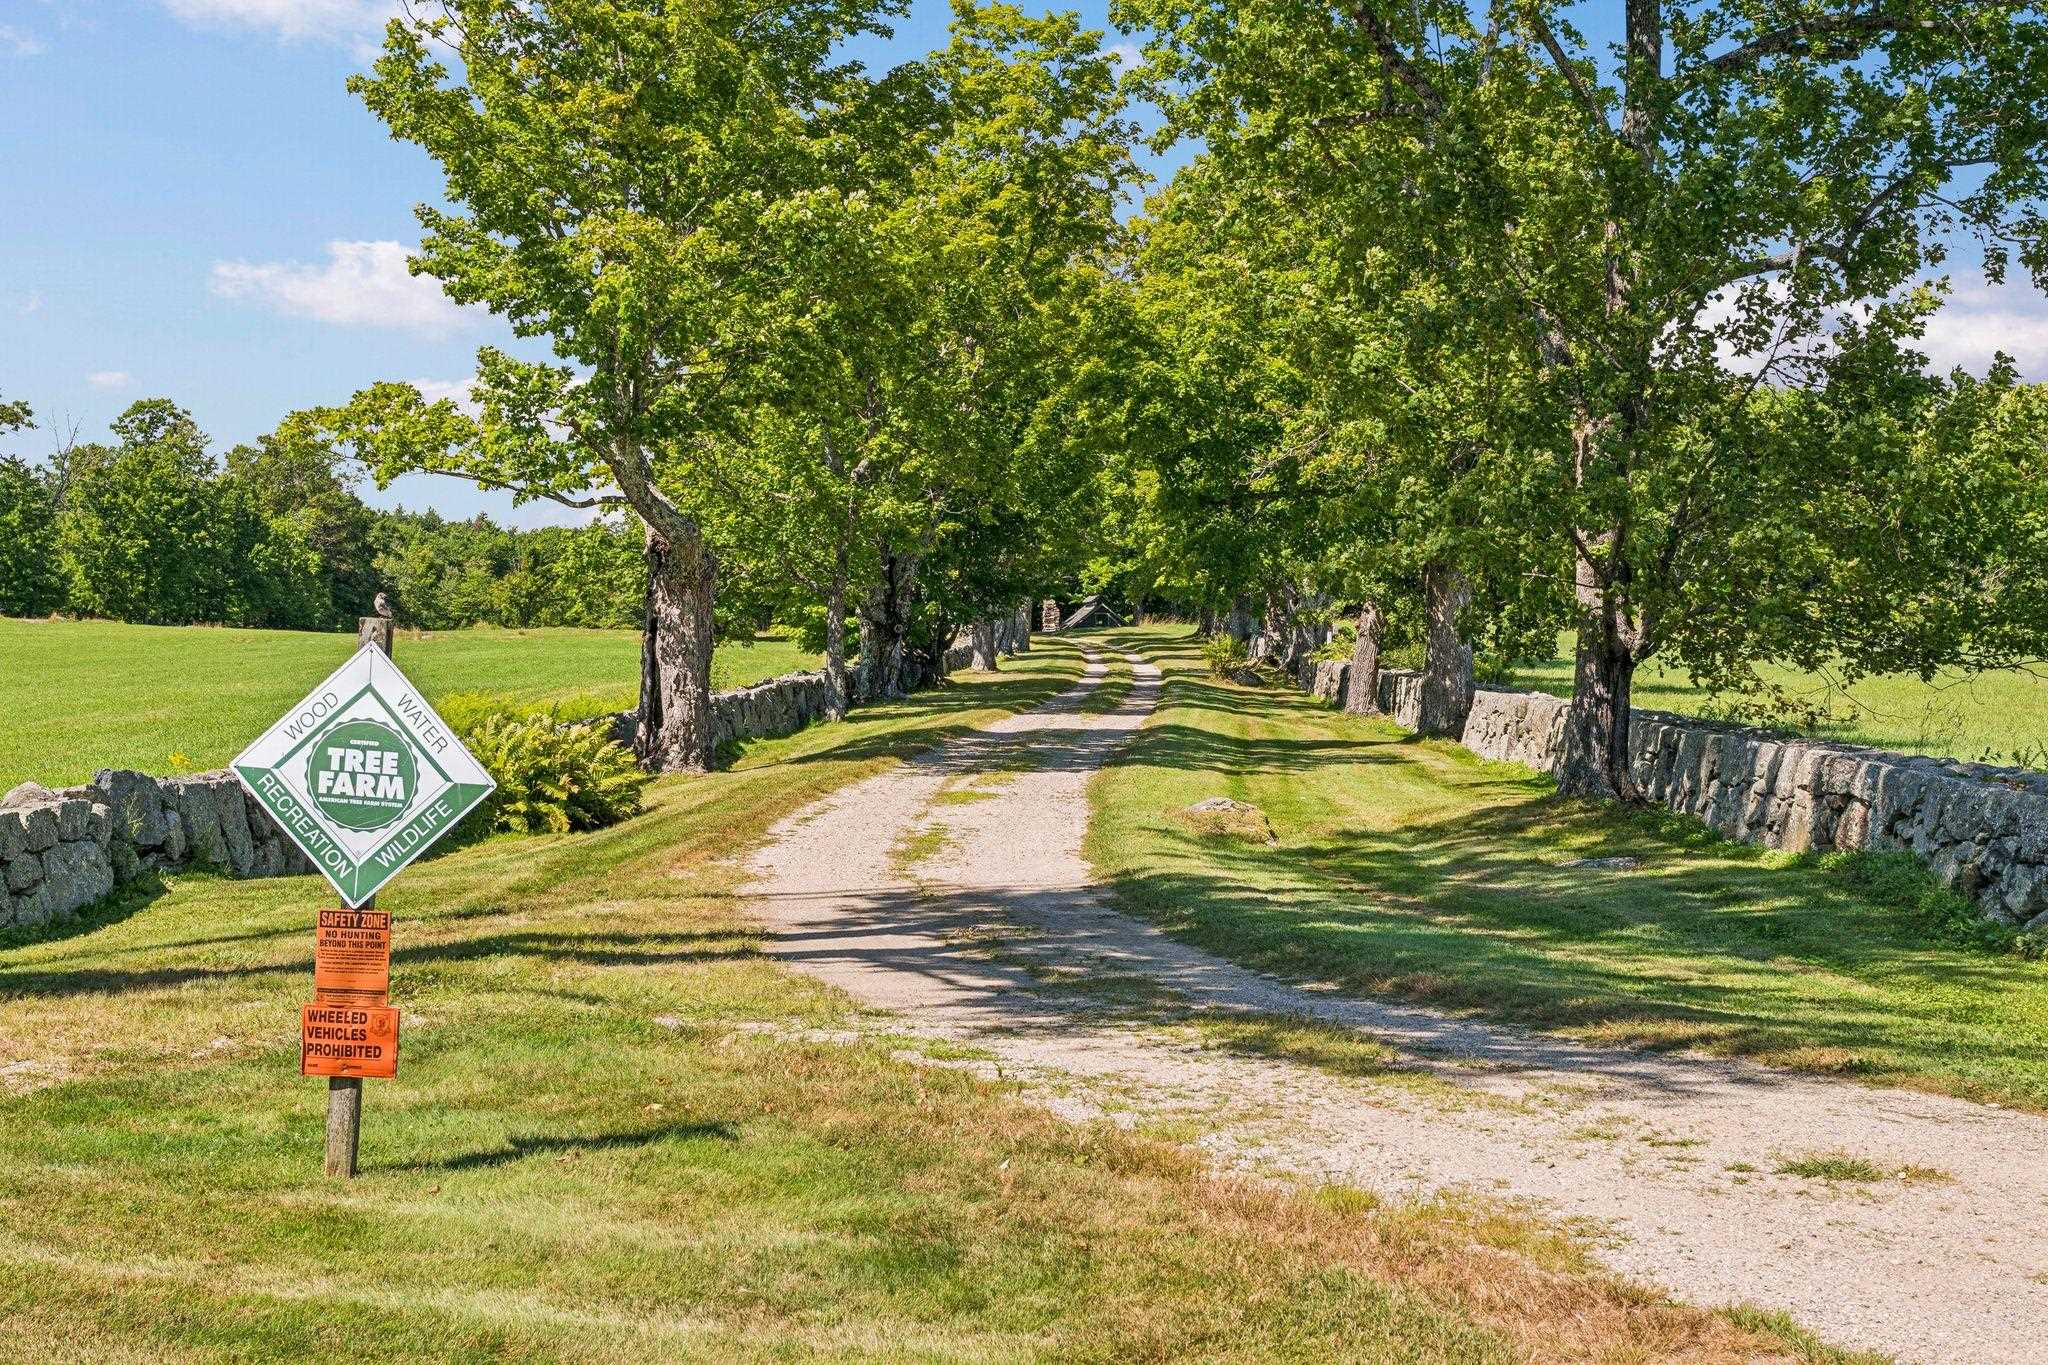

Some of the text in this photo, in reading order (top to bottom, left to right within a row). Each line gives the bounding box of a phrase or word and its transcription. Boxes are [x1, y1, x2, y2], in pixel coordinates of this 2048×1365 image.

[284, 692, 339, 741] WOOD
[397, 693, 448, 754] WATER
[327, 747, 398, 775] TREE
[318, 771, 405, 800] FARM
[257, 774, 353, 879] RECREATION
[375, 799, 453, 868] WILDLIFE
[321, 912, 387, 928] SAFETY ZONE
[320, 940, 386, 950] BEYOND THIS POINT
[325, 930, 381, 940] NO HUNTING
[308, 1010, 368, 1024] WHEELED
[307, 1026, 367, 1041] VEHICLES
[306, 1043, 382, 1058] PROHIBITED
